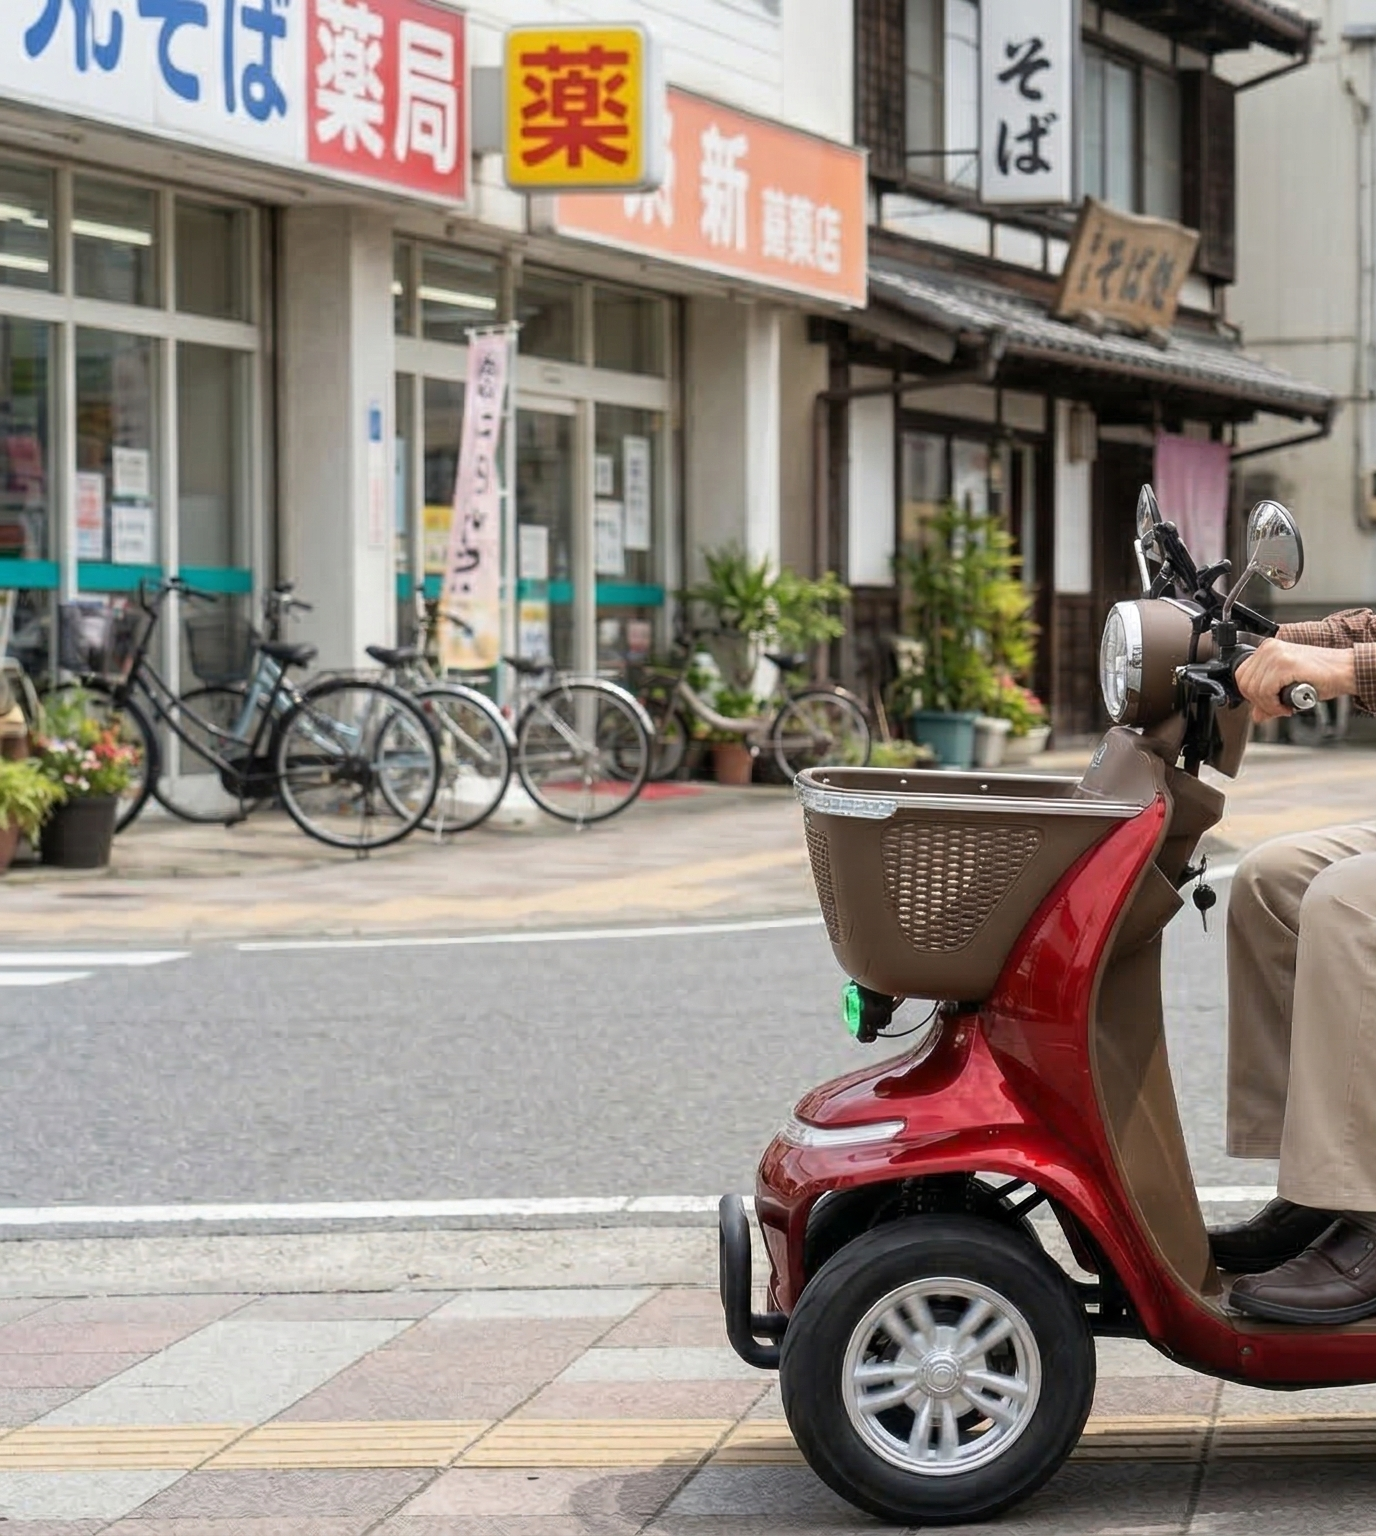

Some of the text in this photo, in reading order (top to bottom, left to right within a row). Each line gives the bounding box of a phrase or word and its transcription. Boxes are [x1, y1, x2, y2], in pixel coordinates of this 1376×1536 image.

[315, 0, 458, 174] 薬局
[520, 45, 630, 168] 薬
[997, 37, 1058, 176] そば
